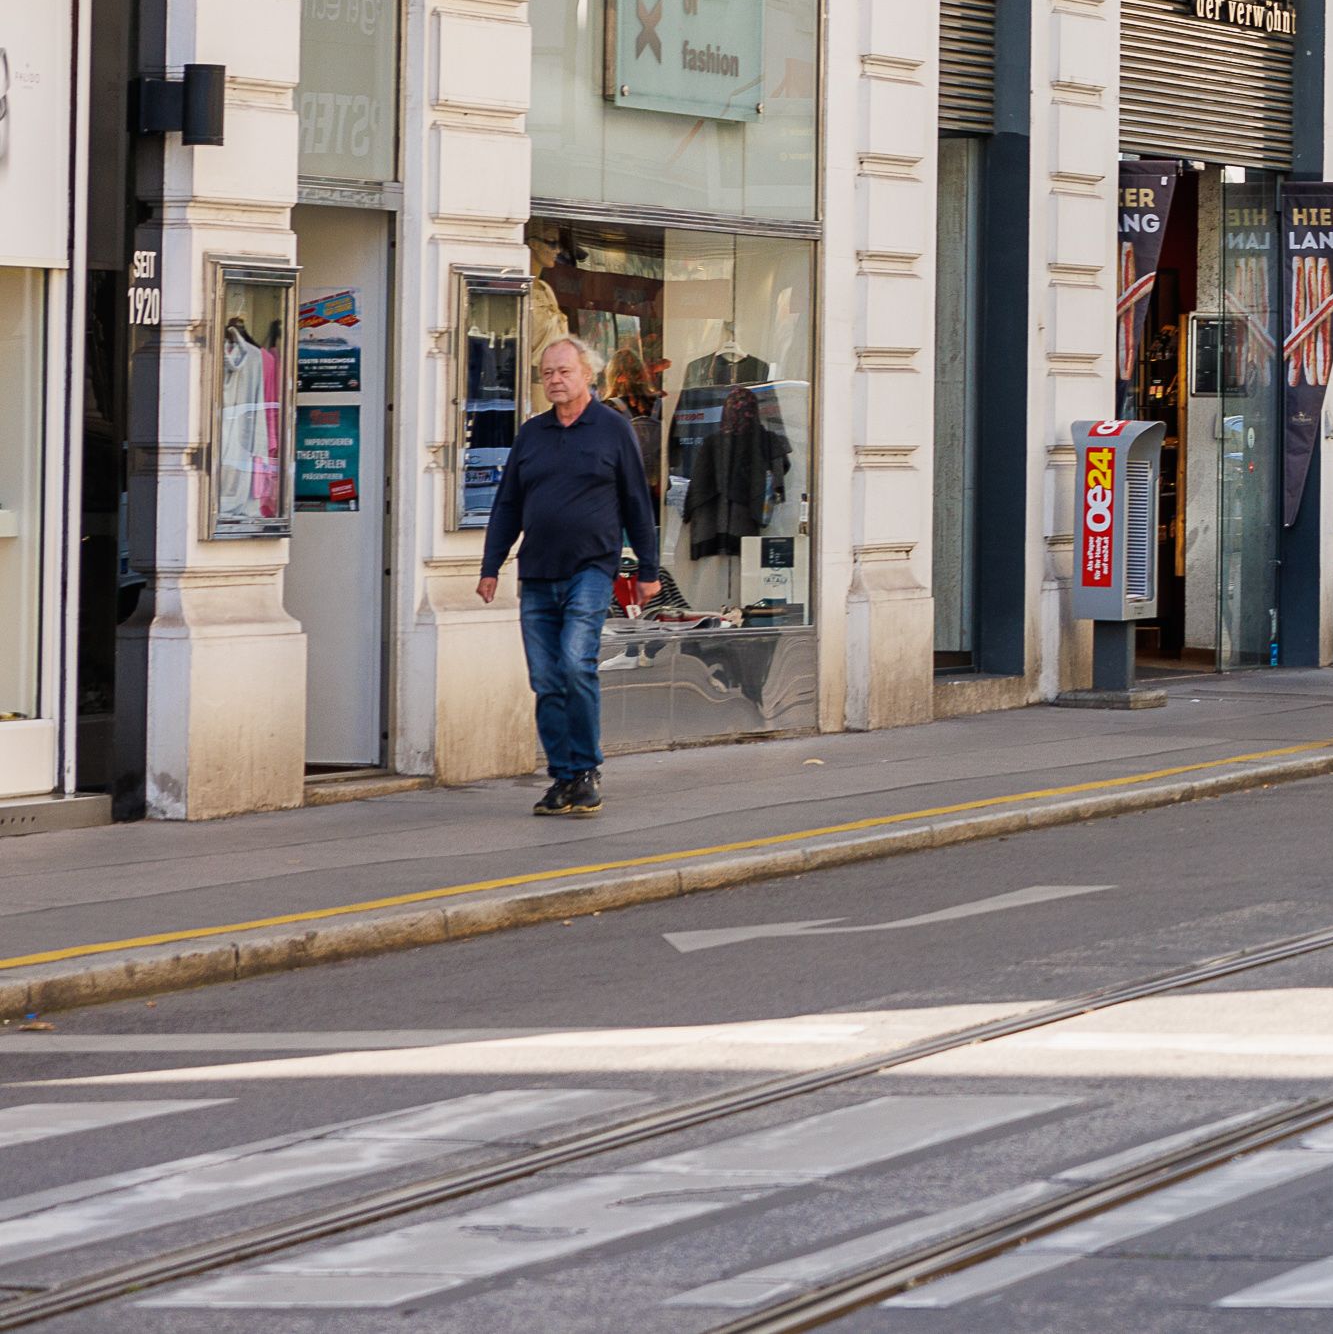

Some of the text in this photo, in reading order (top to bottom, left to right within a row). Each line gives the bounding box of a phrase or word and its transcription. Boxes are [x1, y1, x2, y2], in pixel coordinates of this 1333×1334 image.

[681, 38, 740, 77] fashion
[133, 251, 157, 278] SEIT
[128, 287, 160, 325] 1920
[1086, 447, 1113, 533] oe24
